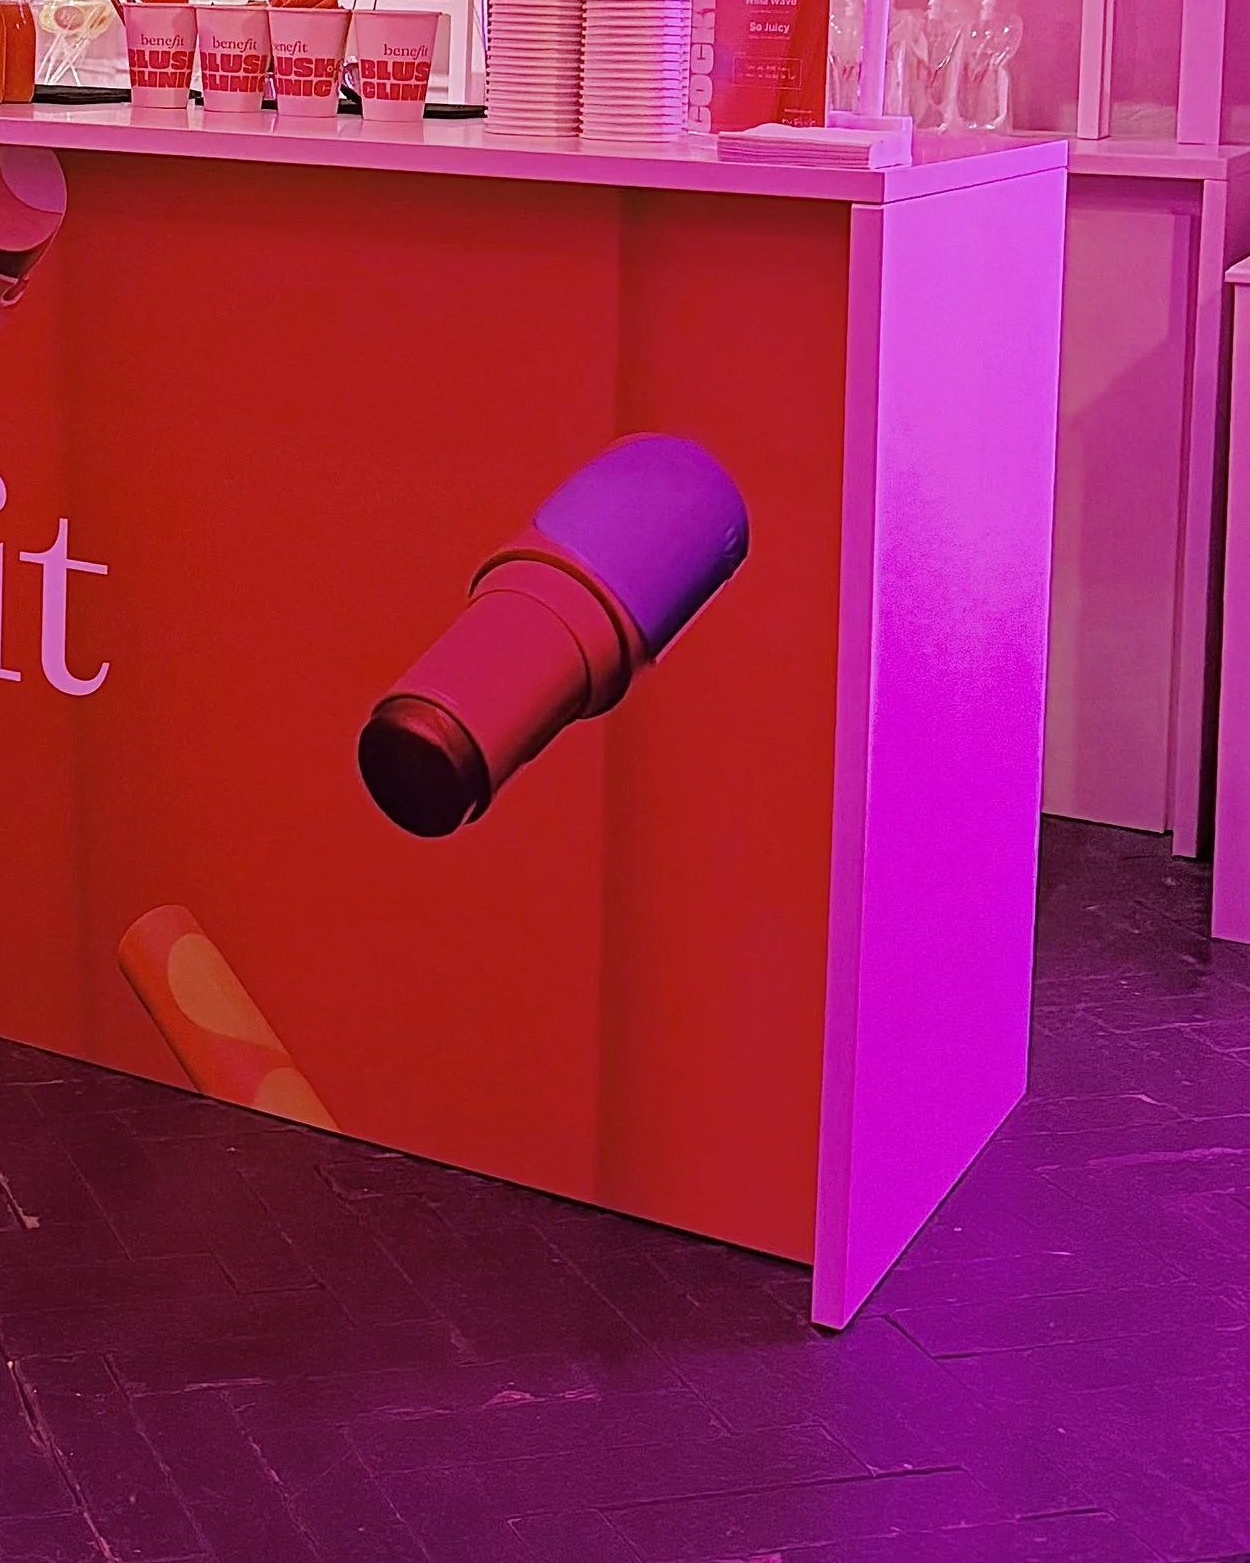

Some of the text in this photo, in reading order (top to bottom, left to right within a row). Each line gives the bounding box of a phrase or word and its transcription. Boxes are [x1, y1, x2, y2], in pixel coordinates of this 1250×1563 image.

[750, 22, 790, 34] So Juicy
[140, 34, 185, 49] benefit
[212, 36, 257, 53] benefit
[383, 43, 429, 60] benefit
